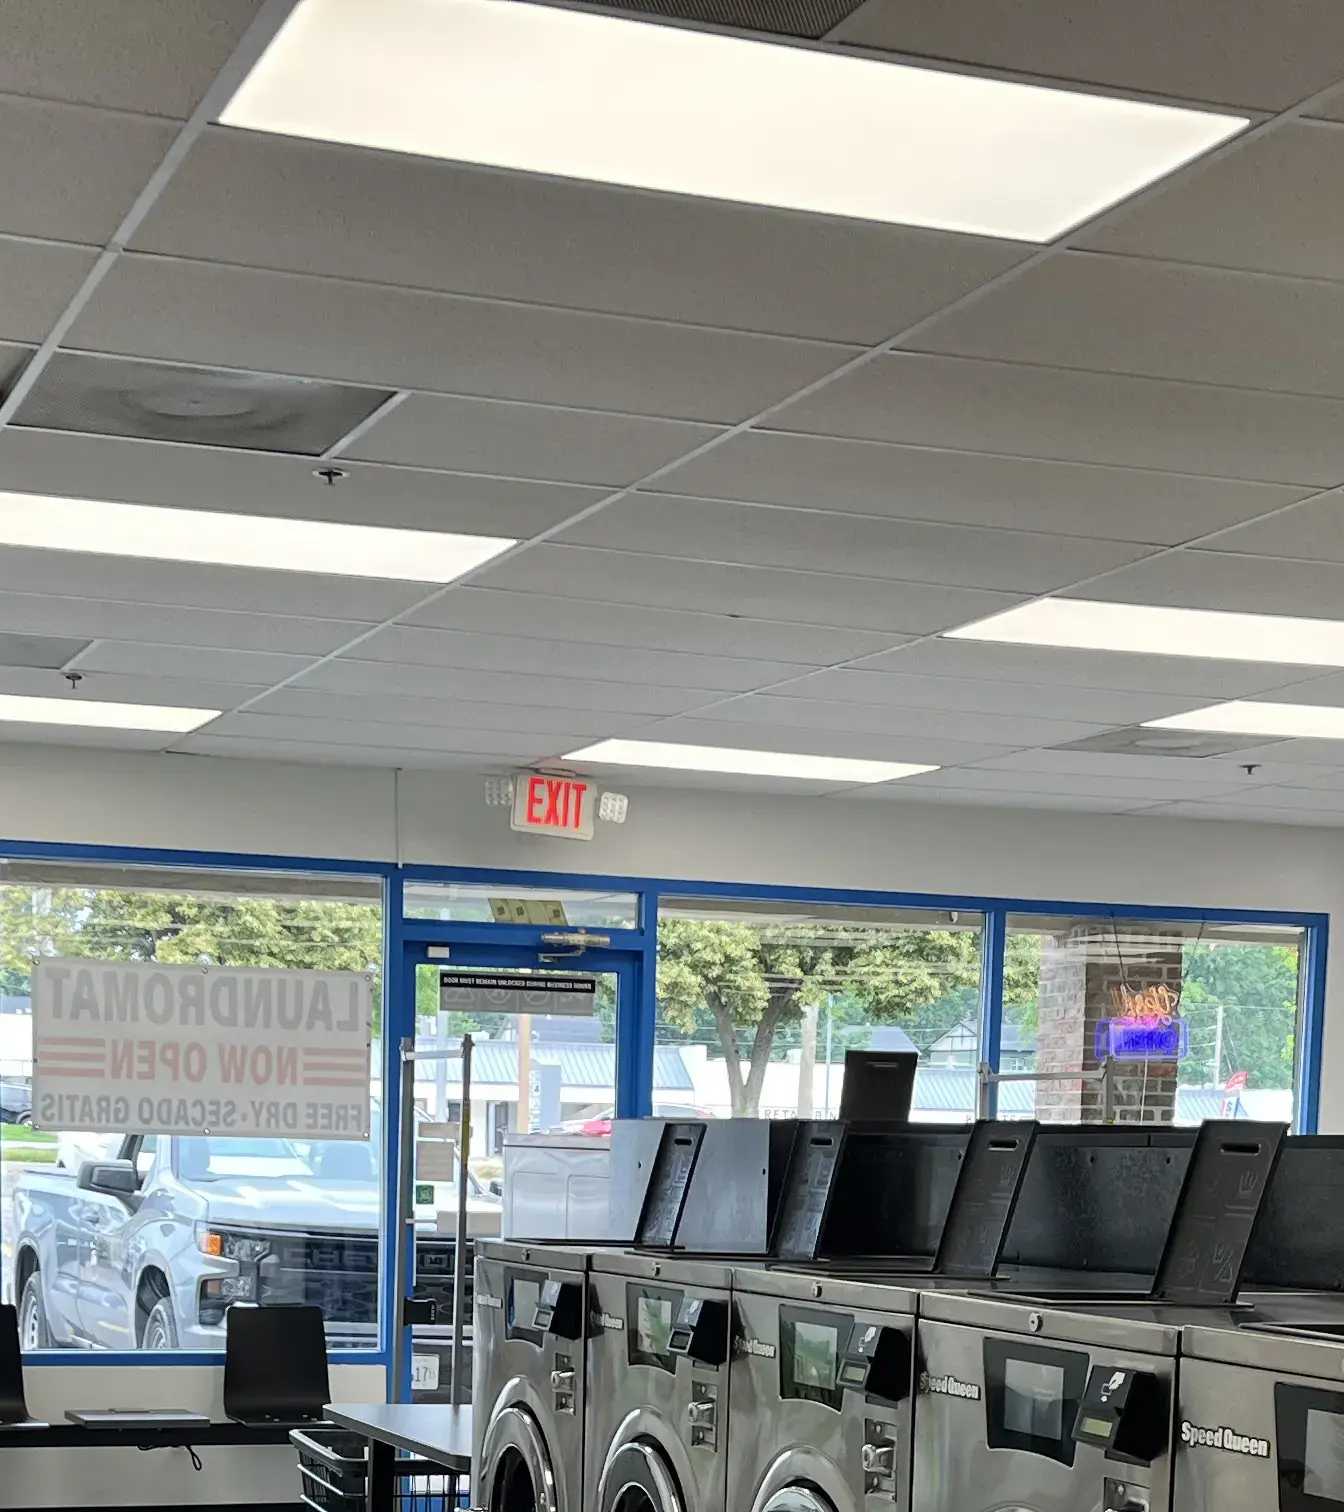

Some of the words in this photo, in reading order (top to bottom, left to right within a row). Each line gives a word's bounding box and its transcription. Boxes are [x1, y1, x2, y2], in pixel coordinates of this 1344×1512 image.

[526, 776, 588, 829] EXIT
[1181, 1421, 1223, 1447] Speed
[1223, 1428, 1268, 1457] Queen
